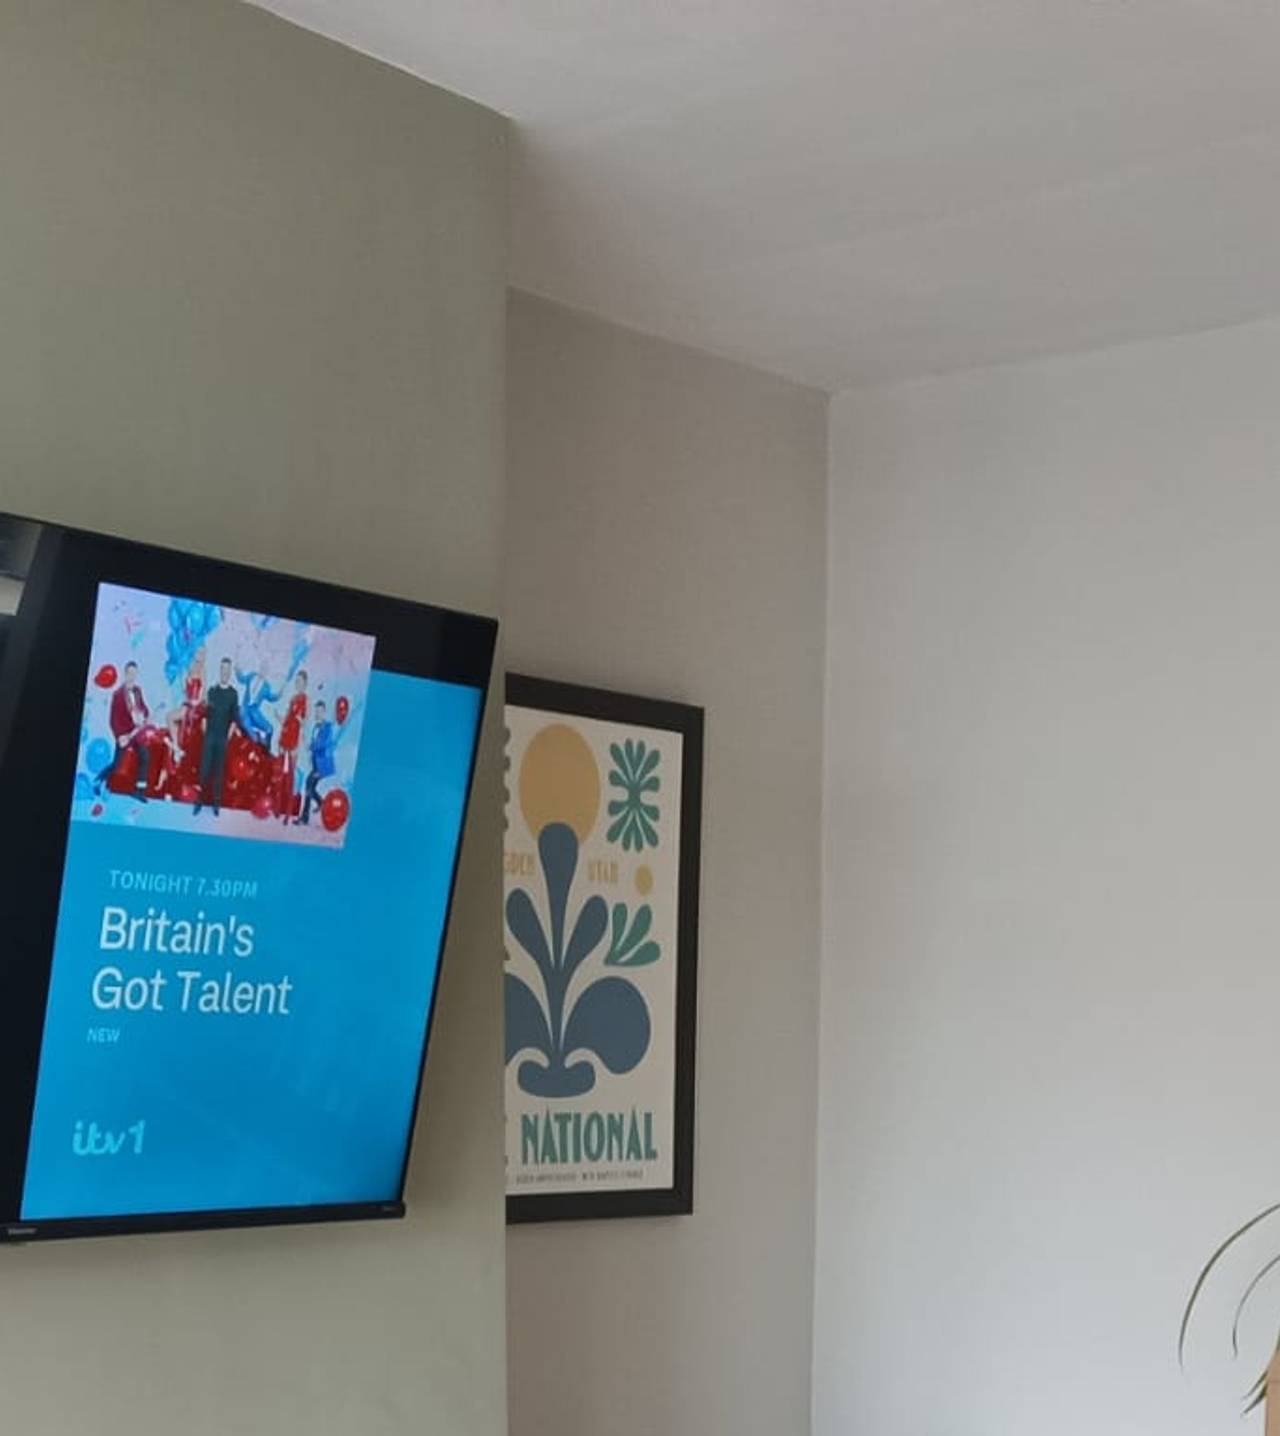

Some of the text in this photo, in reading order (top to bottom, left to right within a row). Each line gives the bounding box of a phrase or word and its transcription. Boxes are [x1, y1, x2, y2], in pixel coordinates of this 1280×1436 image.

[109, 870, 258, 899] TONIGHT 7.30PM
[99, 906, 255, 957] Britain's
[92, 965, 294, 1016] Got Talent
[86, 1026, 121, 1044] NEW
[521, 1103, 658, 1166] NATIONAL
